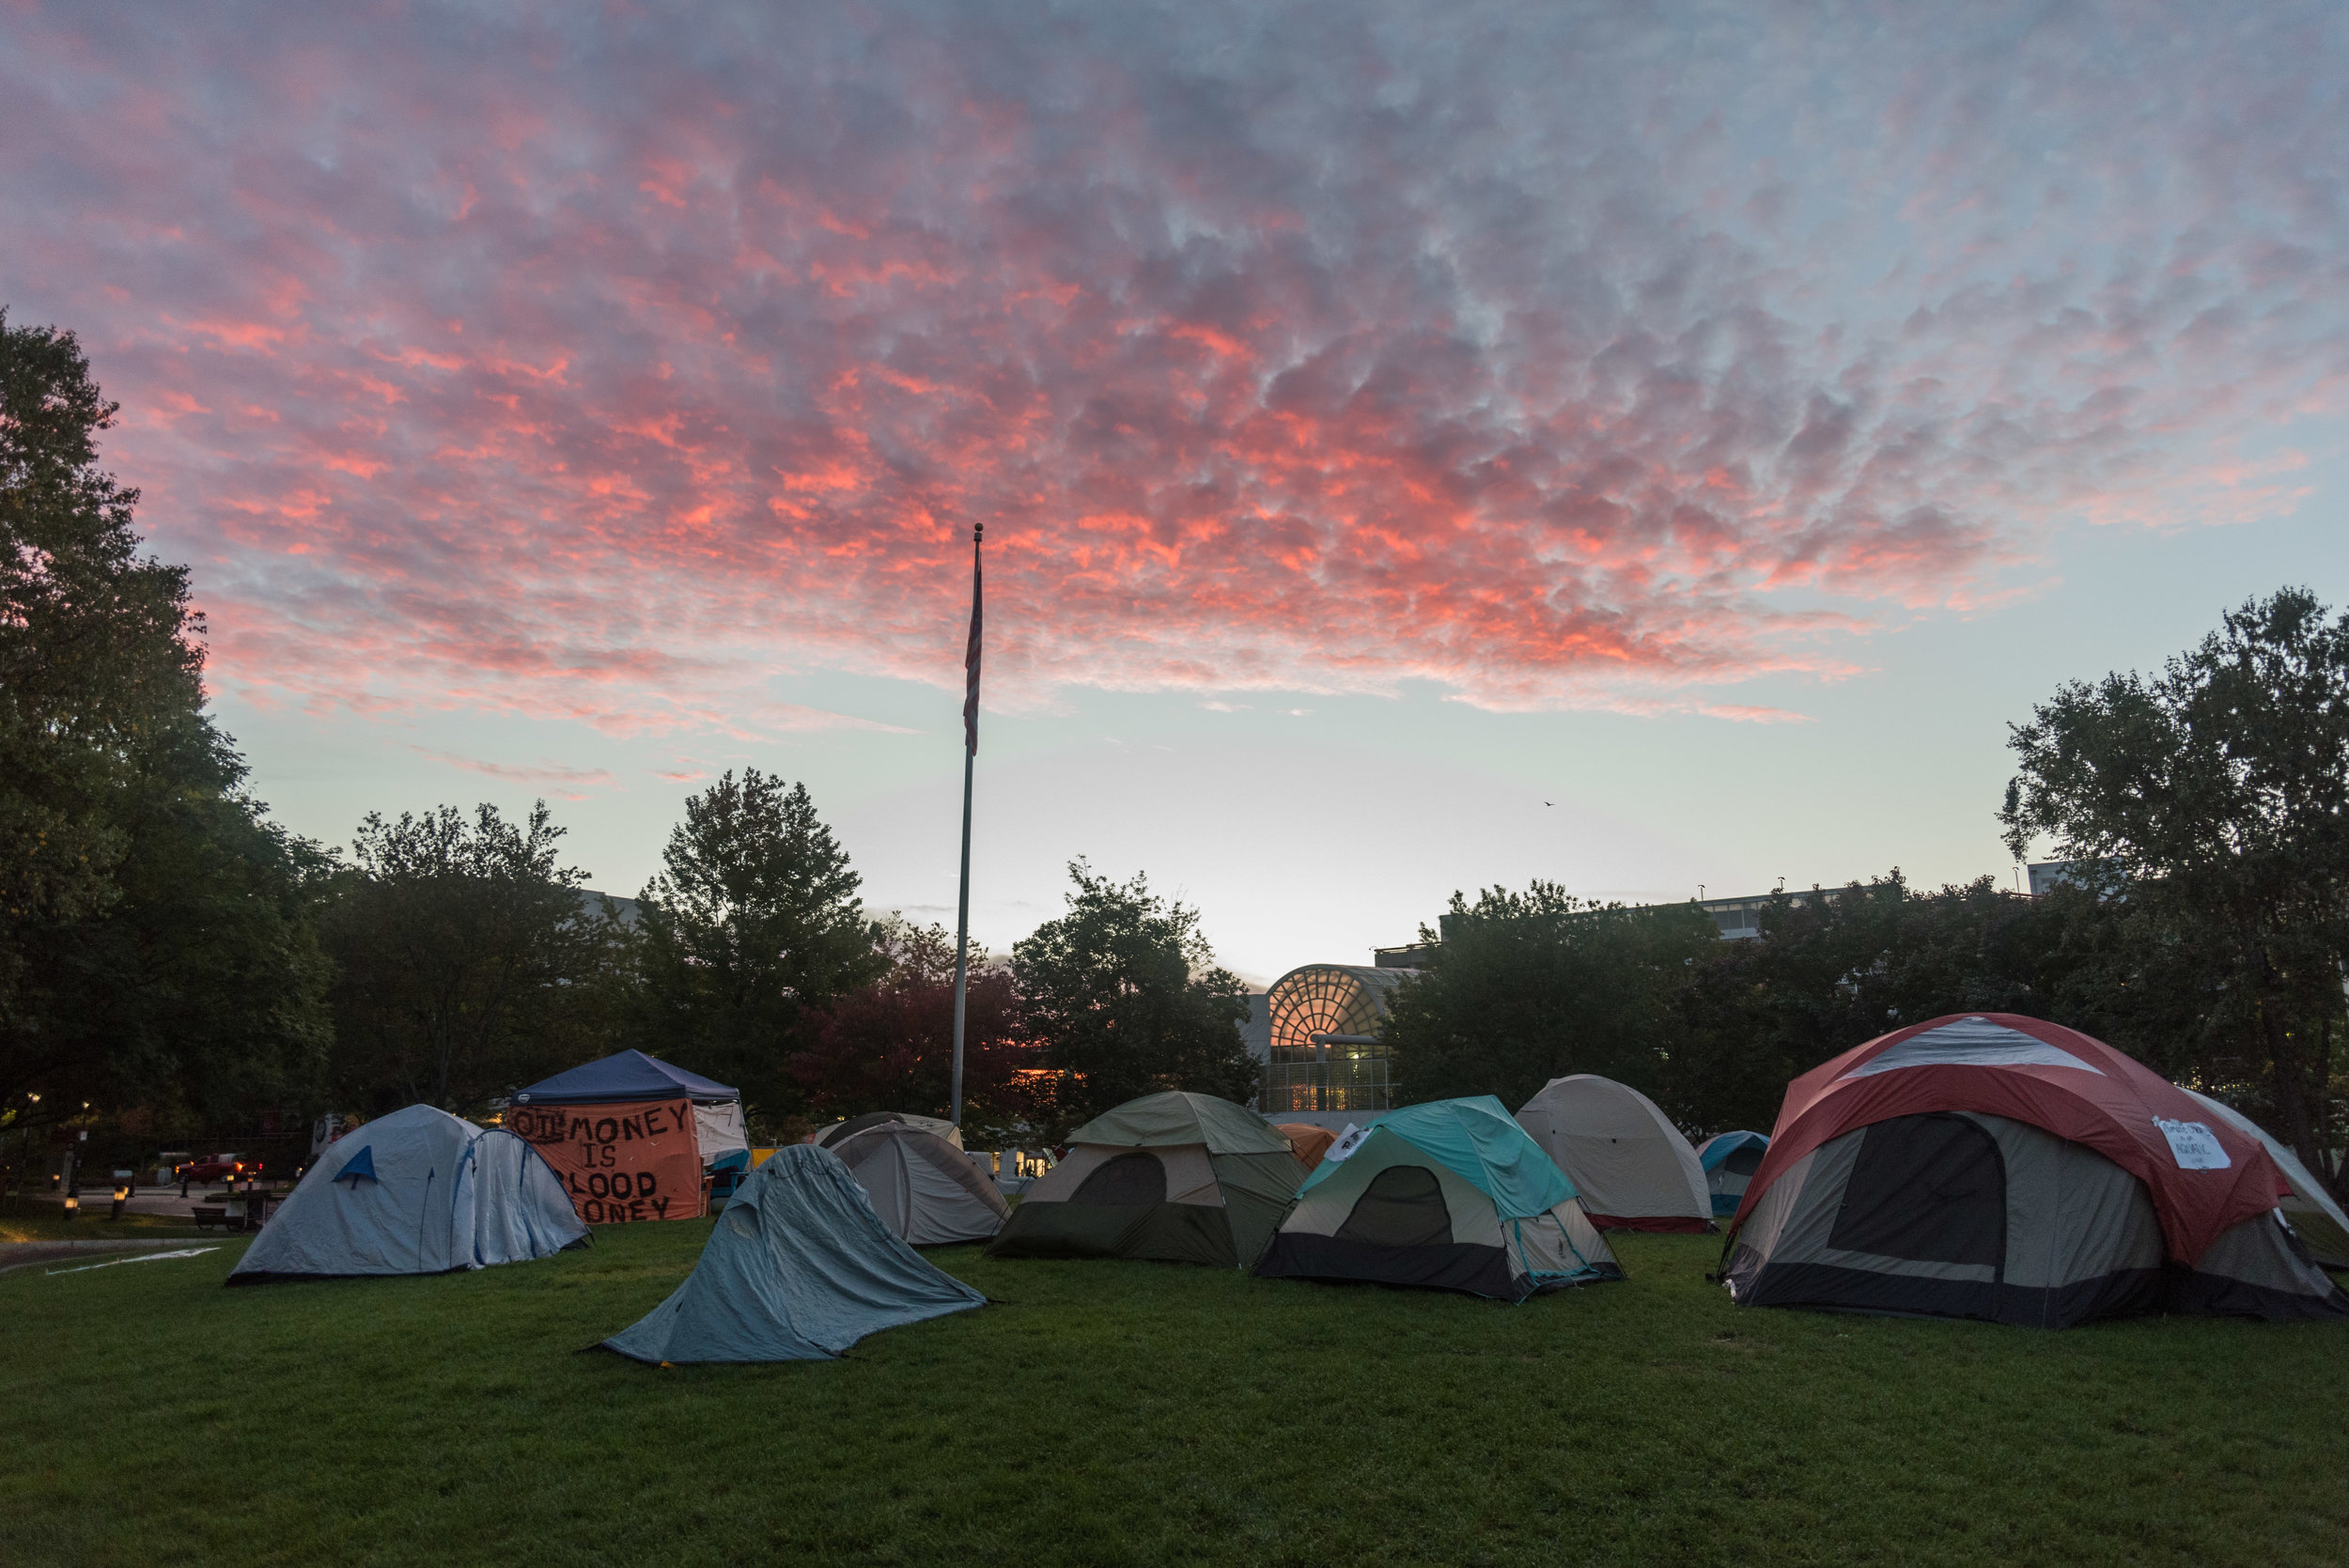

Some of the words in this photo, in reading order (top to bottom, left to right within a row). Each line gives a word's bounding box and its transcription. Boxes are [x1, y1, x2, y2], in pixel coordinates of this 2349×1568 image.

[569, 1103, 688, 1144] MONEY
[583, 1142, 616, 1169] IS
[575, 1196, 670, 1222] ONEY
